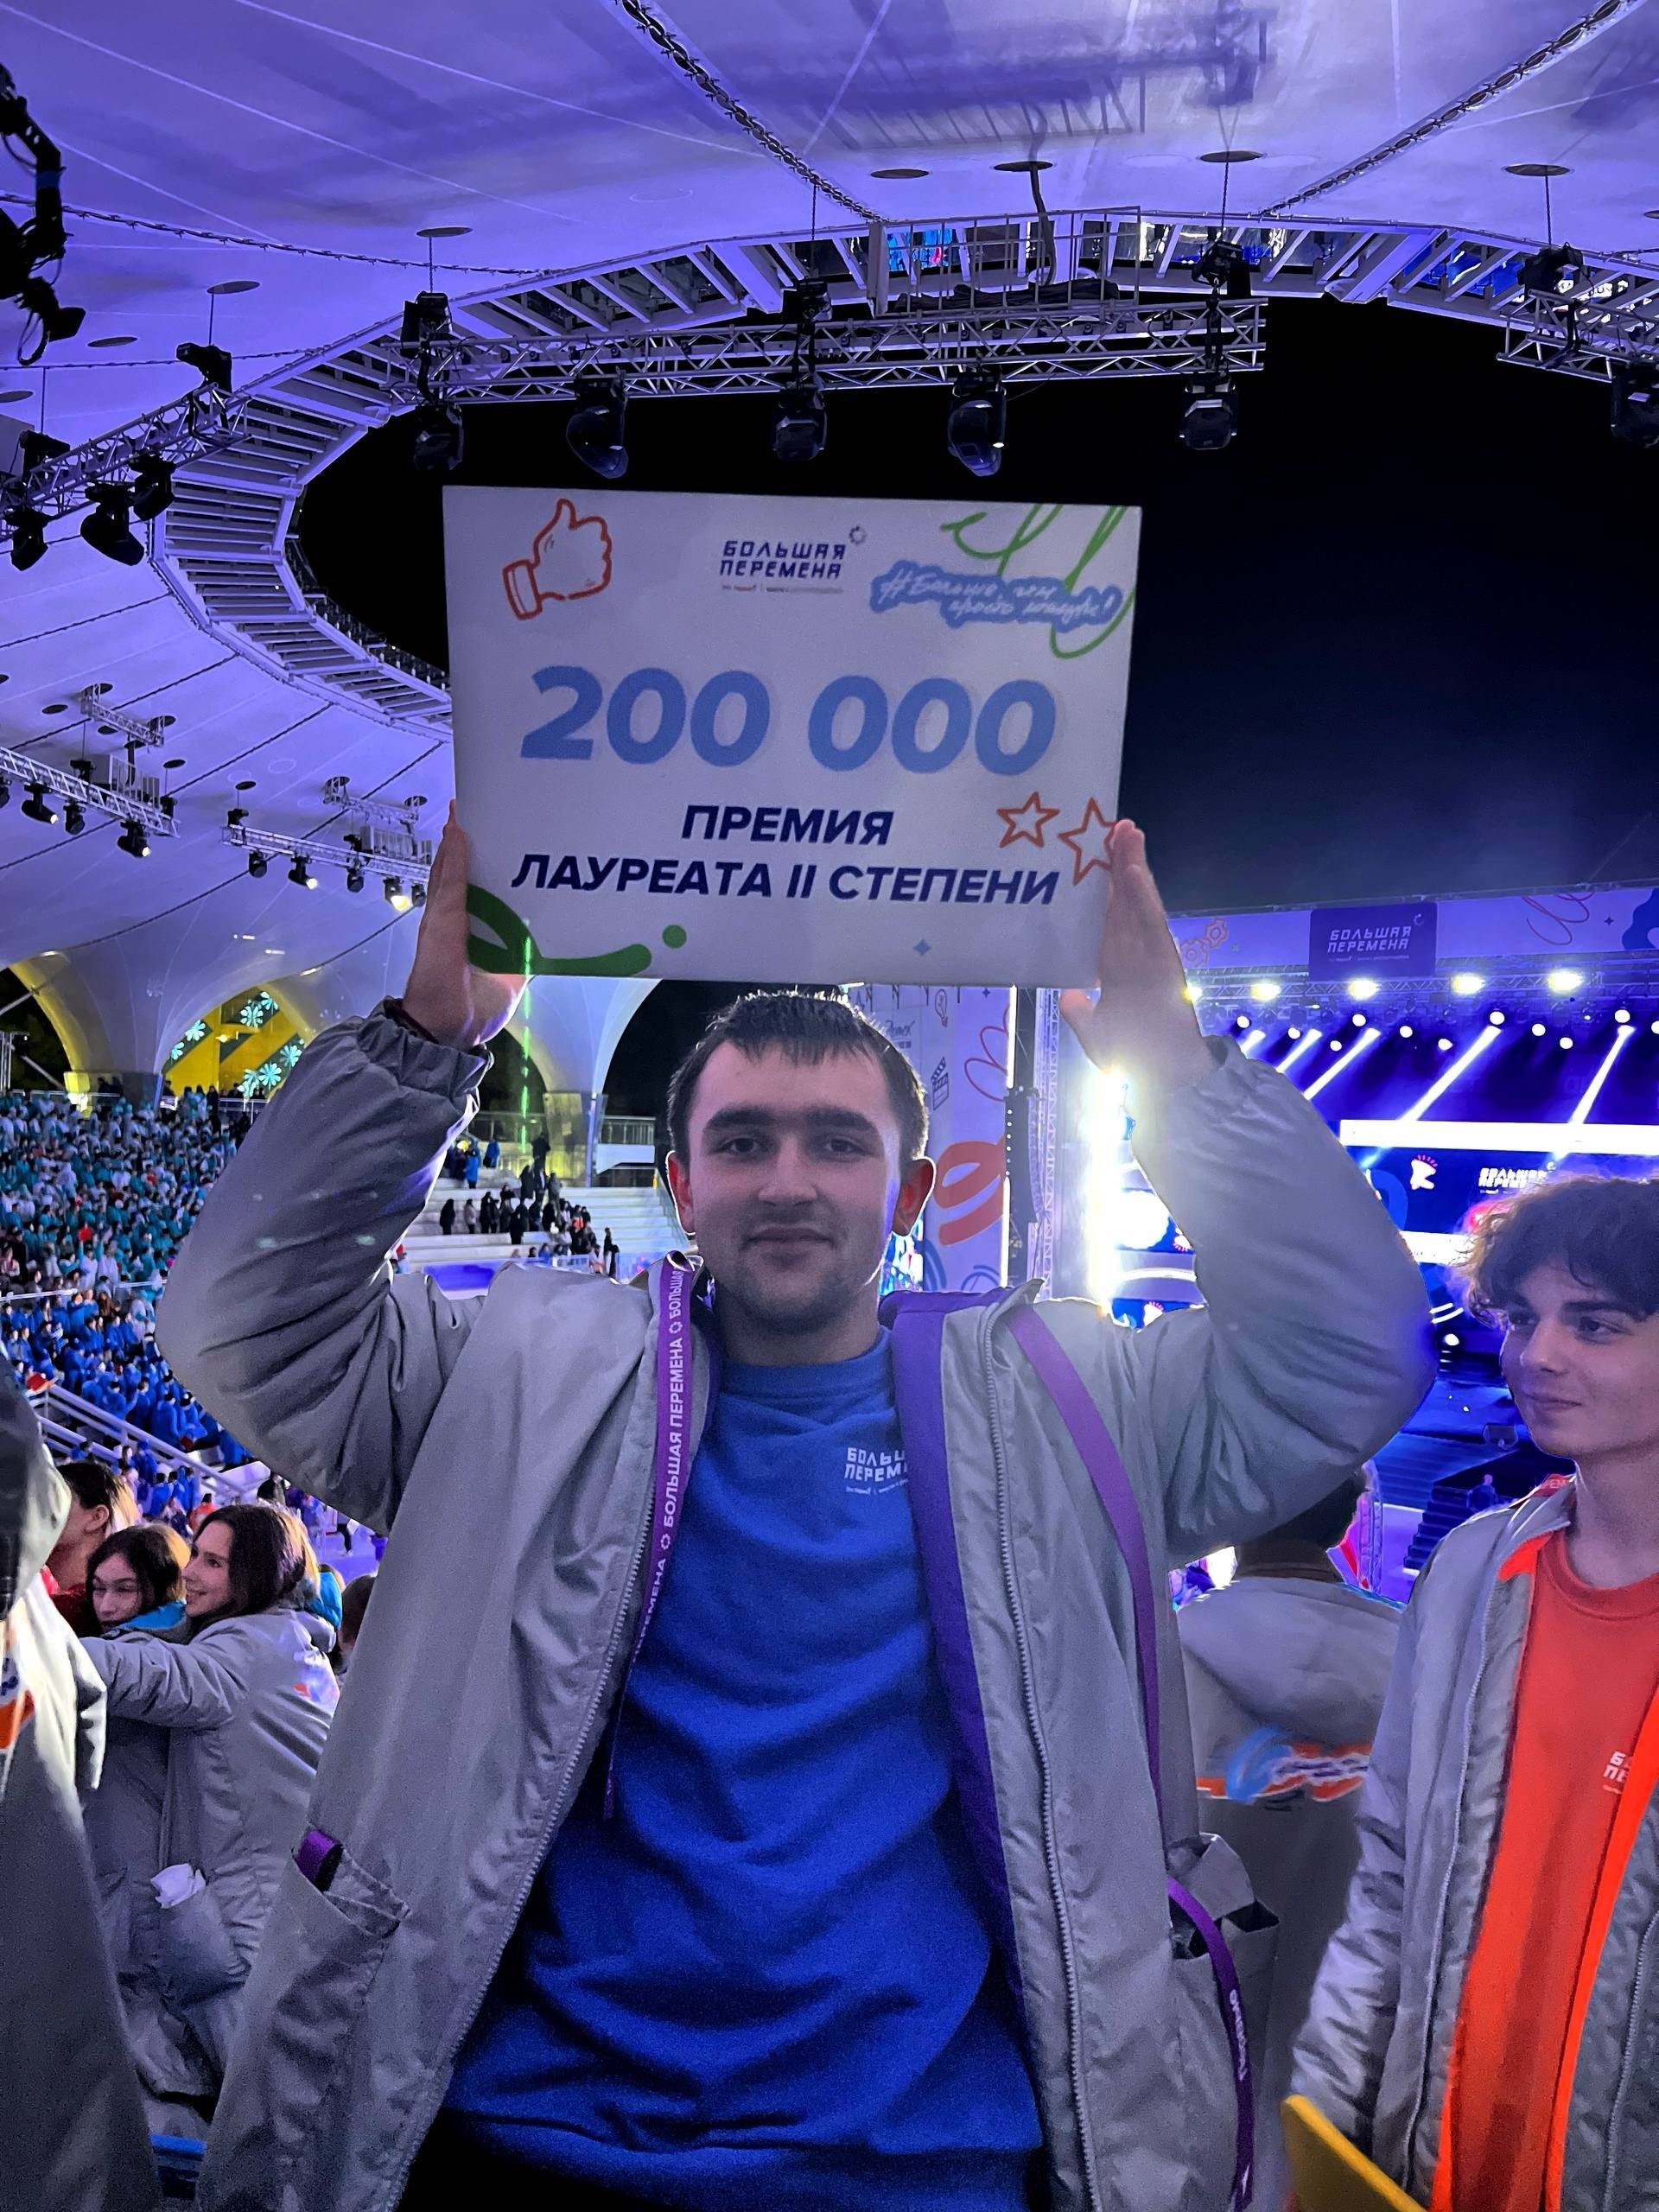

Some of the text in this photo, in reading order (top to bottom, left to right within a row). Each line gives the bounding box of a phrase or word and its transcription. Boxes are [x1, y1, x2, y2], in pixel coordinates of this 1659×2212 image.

[720, 560, 842, 579] ПЕРЕМЕНА
[723, 540, 846, 560] БОЛЬШАЯ
[521, 665, 1055, 776] 200 000
[682, 805, 894, 845] ПРЕМИЯ
[511, 854, 1060, 905] ЛАУРЕАТА II СТЕПЕНИ
[1327, 938, 1409, 954] ПЕРЕМЕНА
[1330, 925, 1412, 941] БОЛЬШАЯ
[668, 1337, 684, 1427] ПЕРЕМЕНА
[664, 1433, 683, 1528] БОЛЬШАЯ
